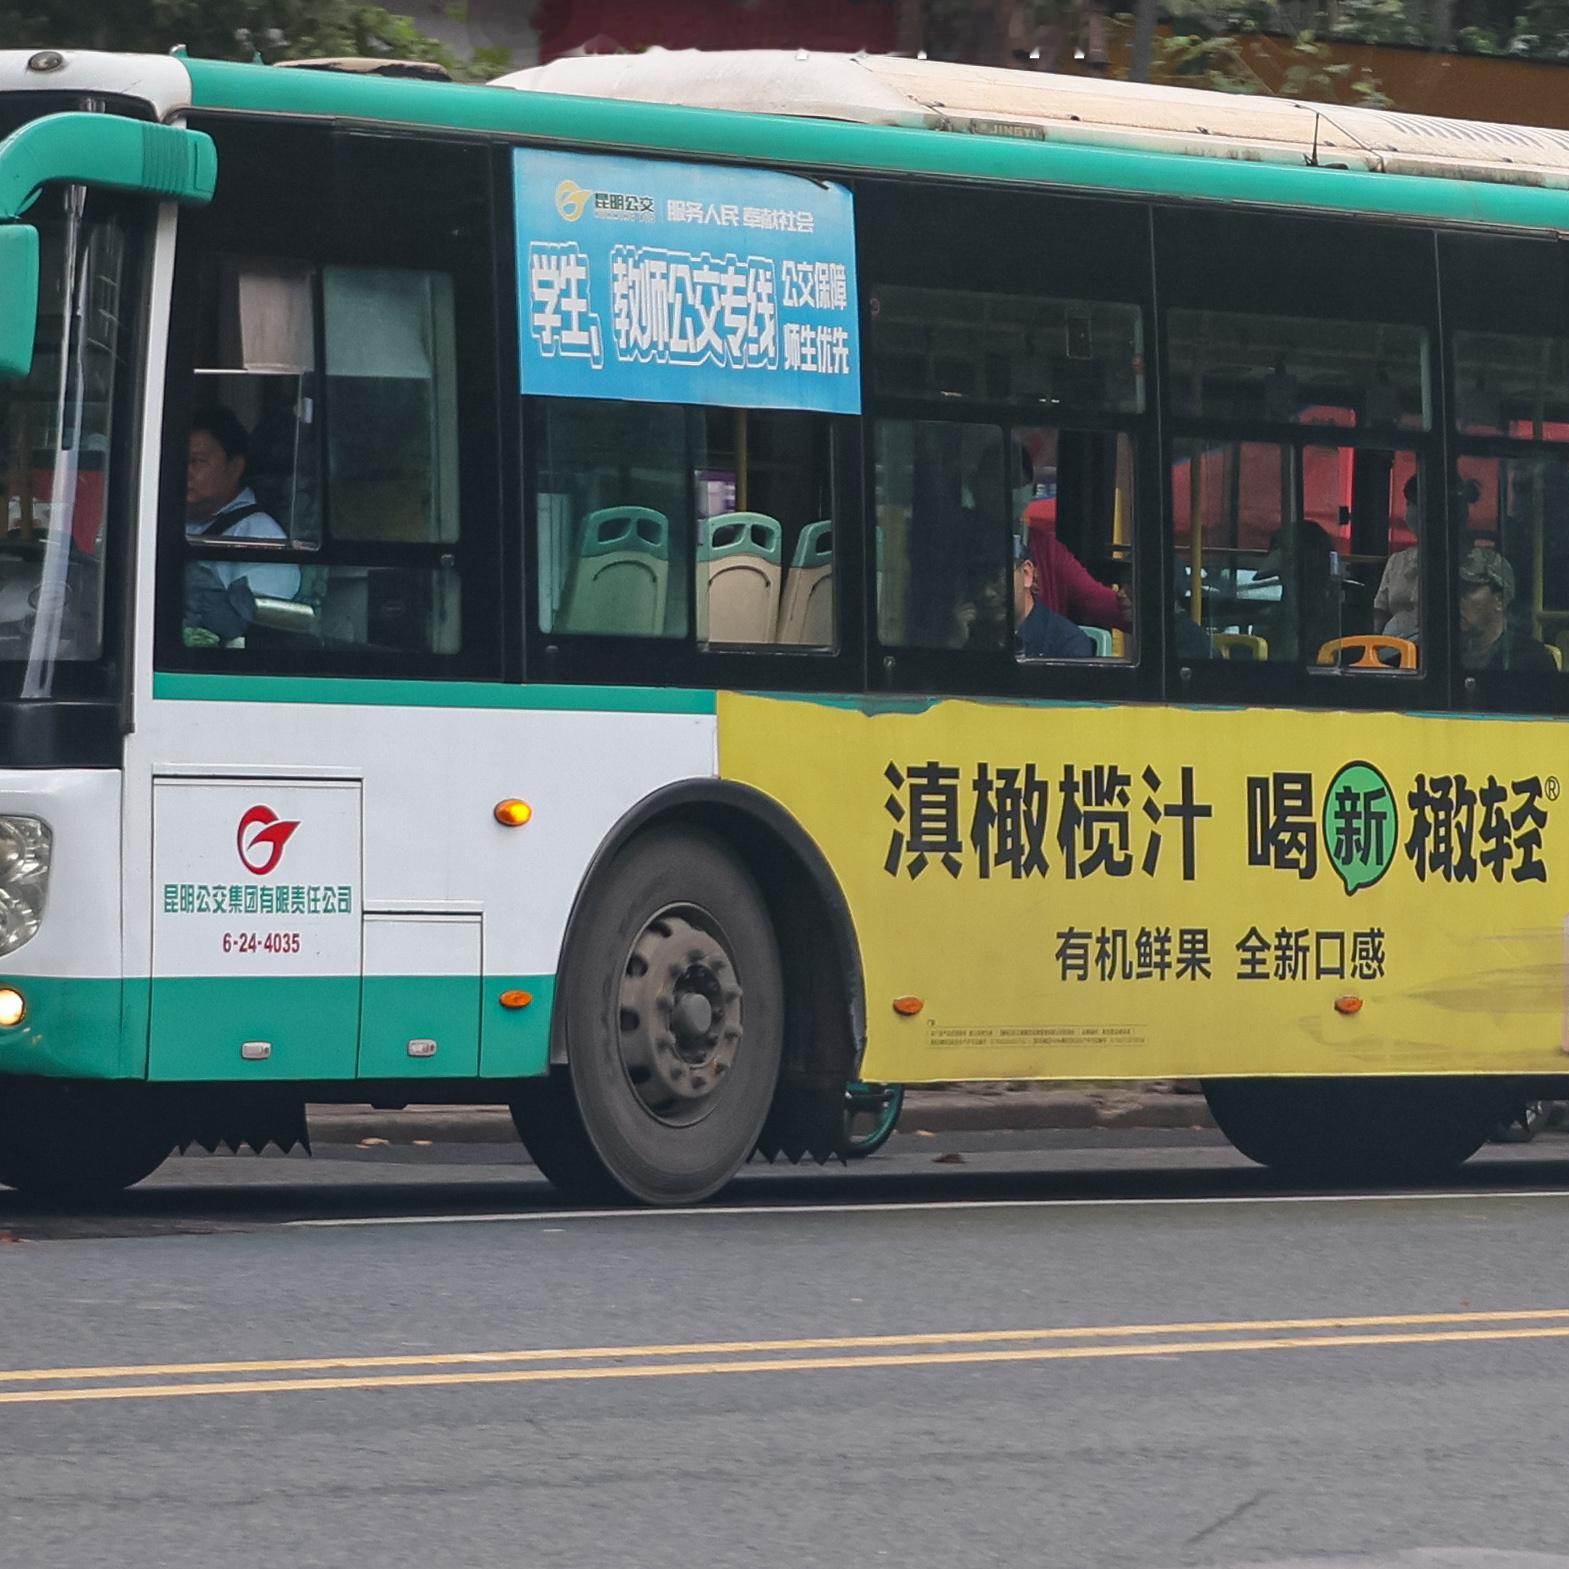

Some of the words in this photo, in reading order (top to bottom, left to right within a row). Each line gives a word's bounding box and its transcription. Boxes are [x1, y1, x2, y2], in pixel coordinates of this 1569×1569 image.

[593, 191, 655, 213] 昆明公交
[666, 198, 740, 228] 服务人民
[743, 207, 815, 233] 奉献社会
[782, 260, 848, 311] 公交保障
[784, 323, 849, 375] 师生优先
[883, 760, 1213, 881] 滇橄榄汁
[164, 884, 352, 914] 昆明公交集团有限责任公司
[1055, 925, 1212, 981] 有机鲜果
[1234, 925, 1386, 981] 全新口感
